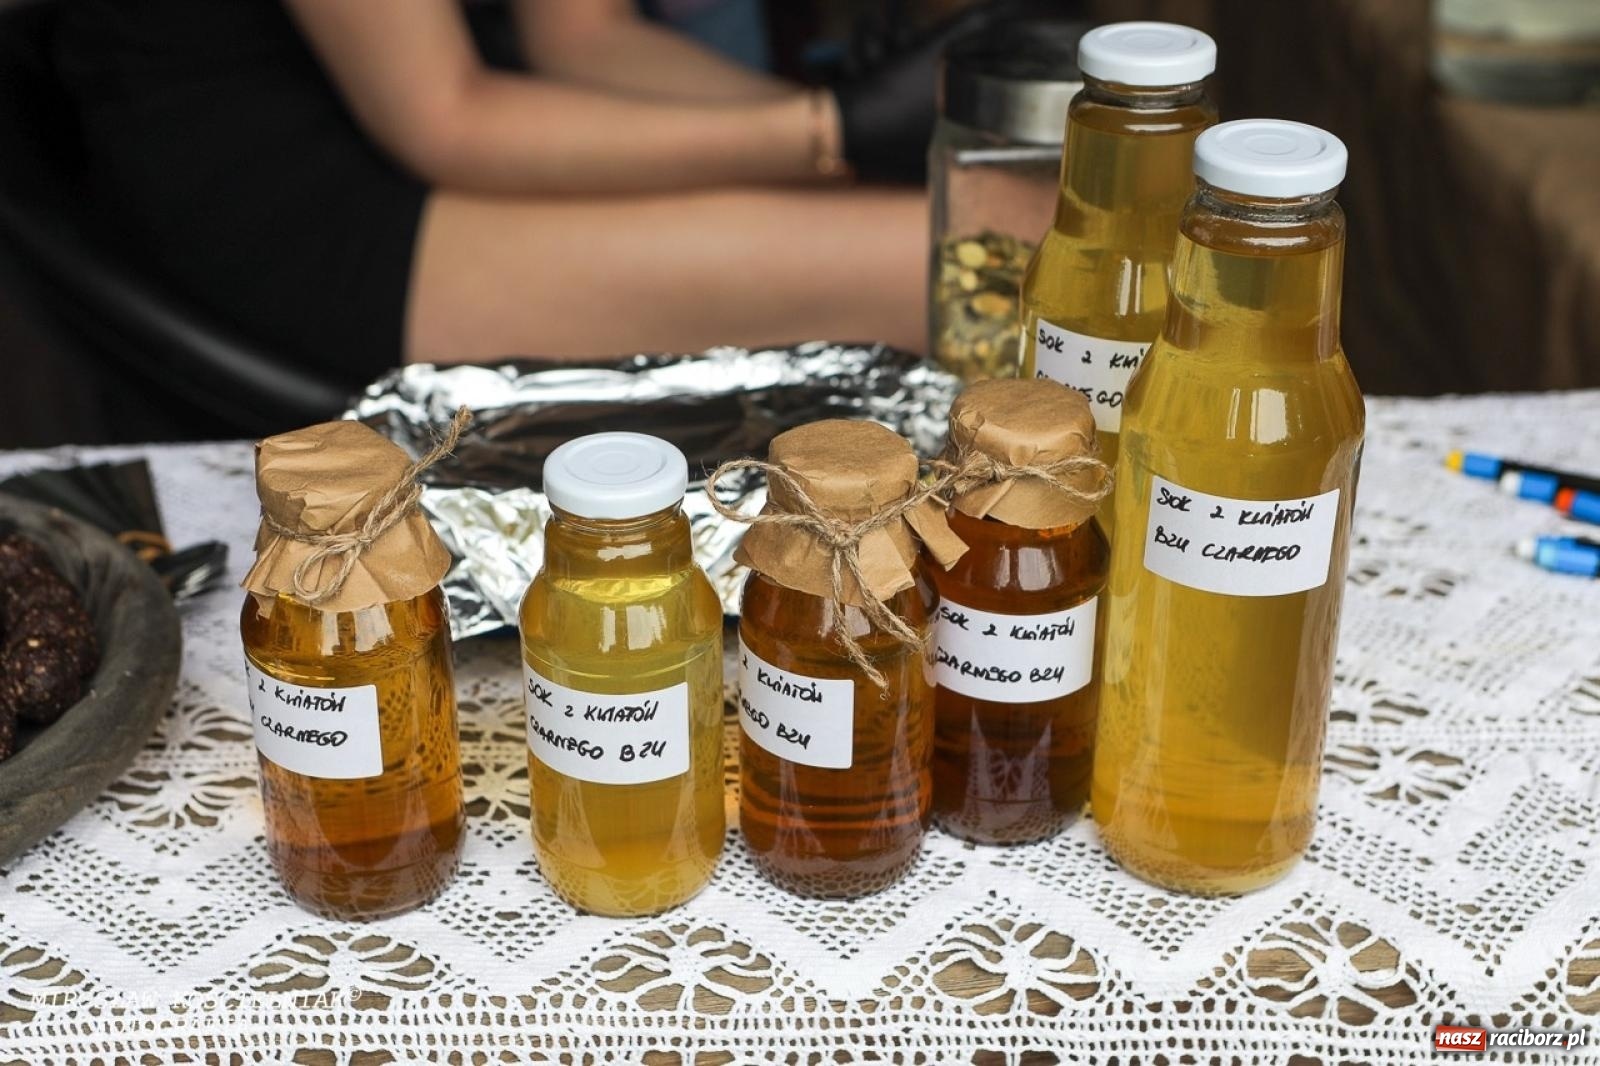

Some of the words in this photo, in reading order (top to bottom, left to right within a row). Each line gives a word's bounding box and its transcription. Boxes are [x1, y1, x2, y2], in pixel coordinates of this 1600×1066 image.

[1038, 328, 1065, 354] SOK
[1156, 487, 1193, 512] SOK
[1202, 543, 1301, 564] CZARNEGO
[939, 606, 970, 632] SOK
[528, 677, 553, 708] SOK
[530, 715, 605, 760] CZARNEGO
